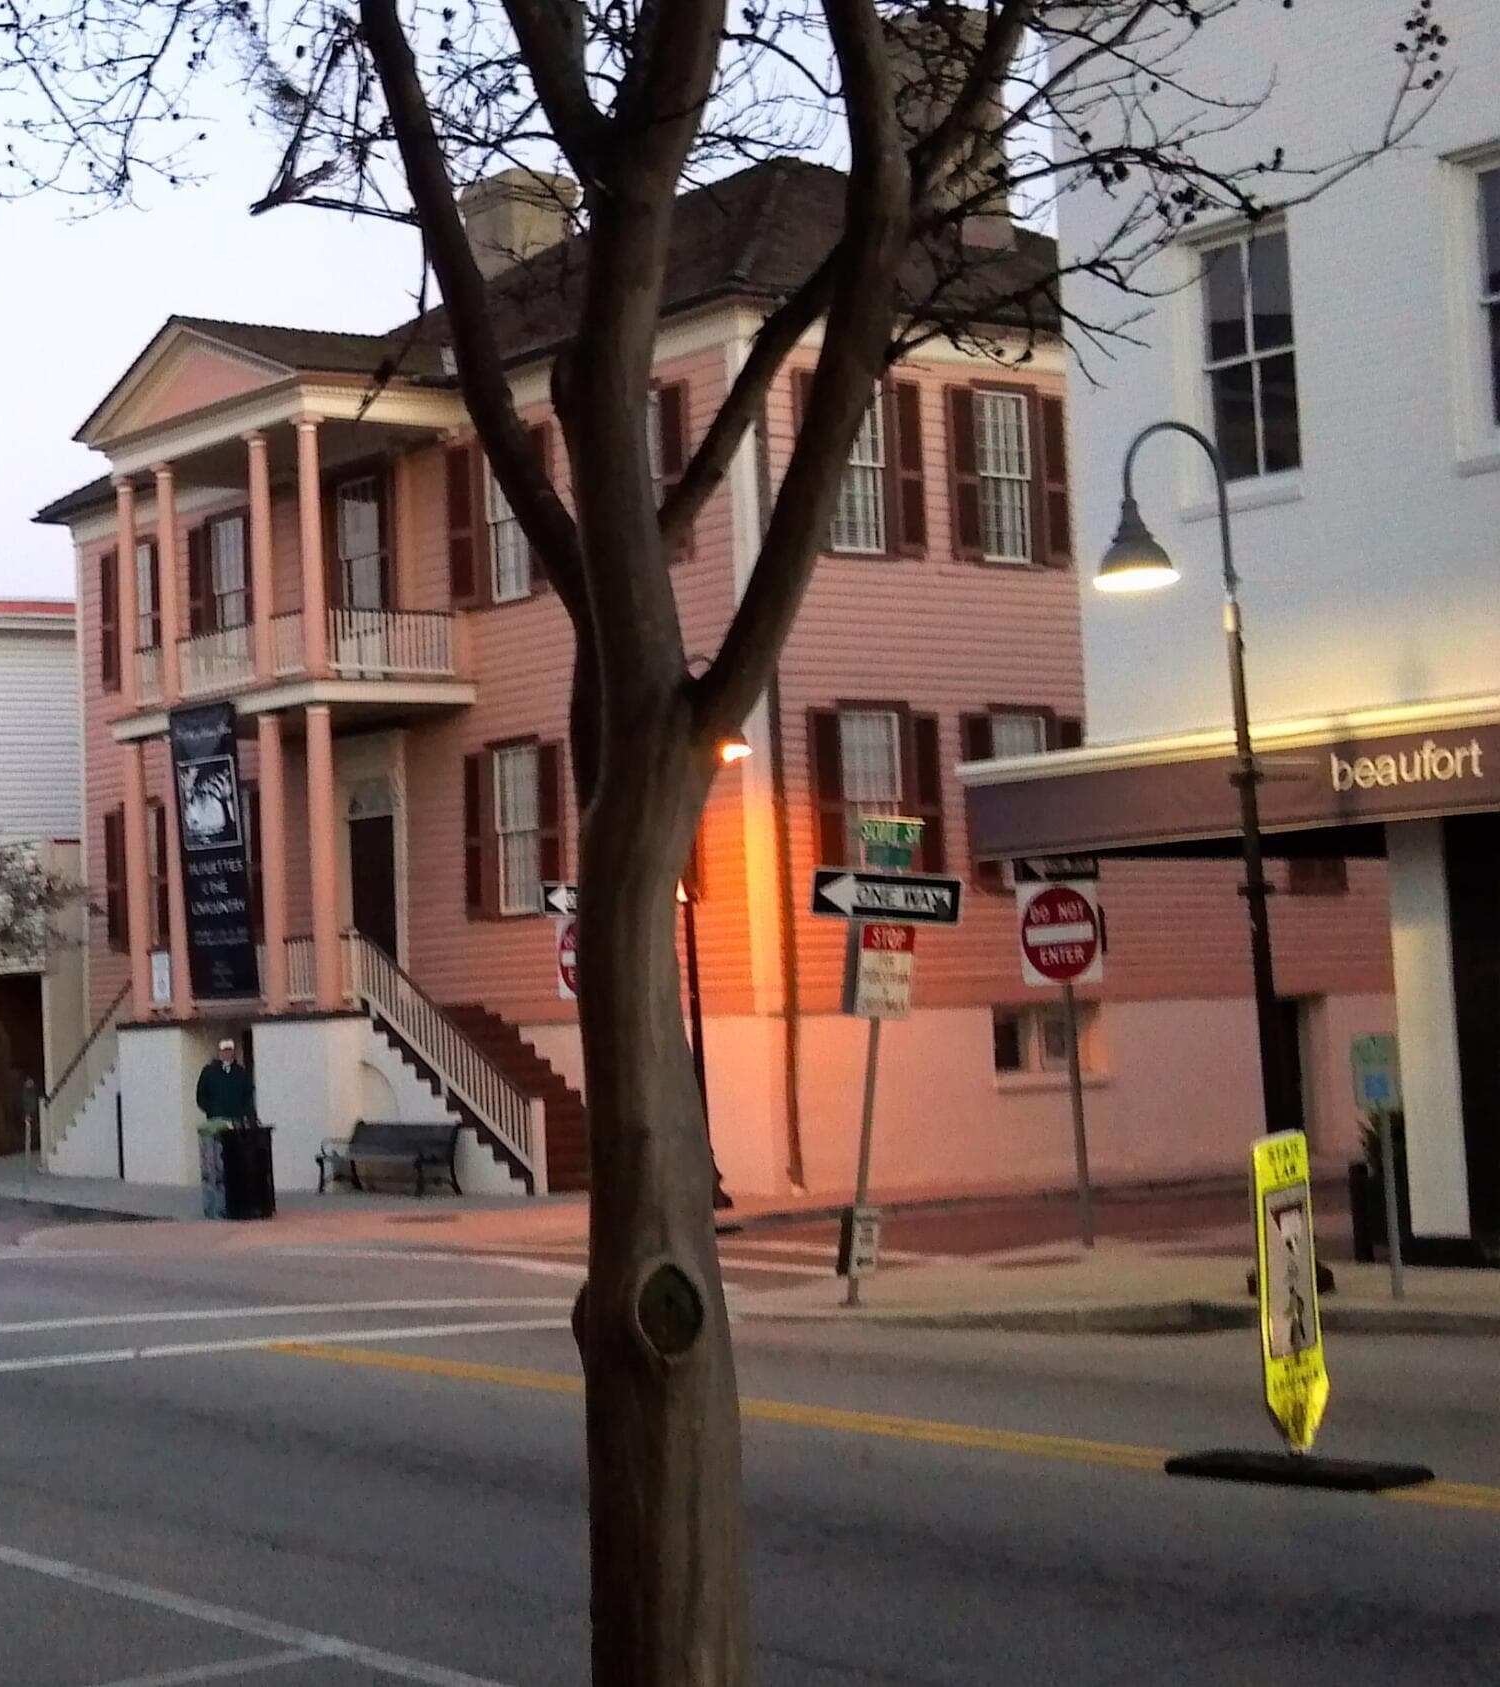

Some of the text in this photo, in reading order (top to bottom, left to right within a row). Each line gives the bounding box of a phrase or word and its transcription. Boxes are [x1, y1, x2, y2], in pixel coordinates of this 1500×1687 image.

[1329, 736, 1484, 792] beaufort
[856, 883, 952, 913] ONE WAY
[1029, 901, 1085, 923] DO NOT
[871, 926, 907, 949] STOP
[1039, 944, 1086, 966] ENTER
